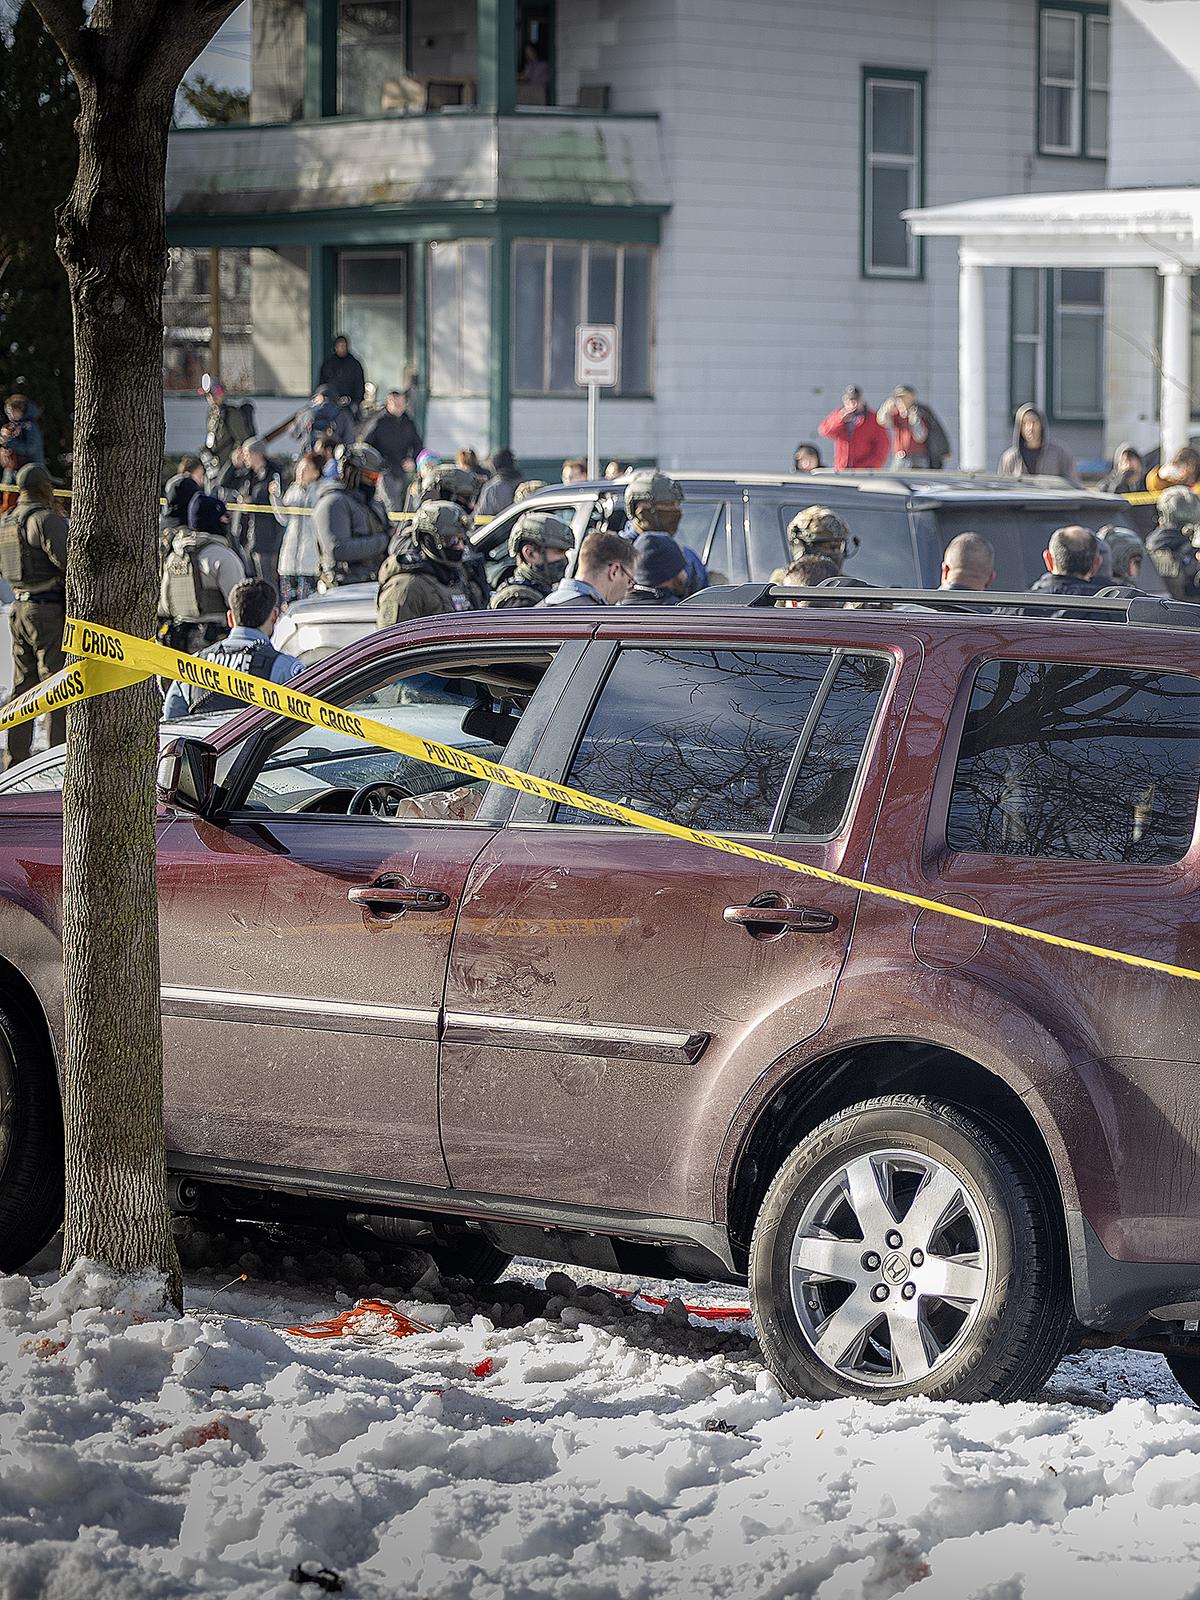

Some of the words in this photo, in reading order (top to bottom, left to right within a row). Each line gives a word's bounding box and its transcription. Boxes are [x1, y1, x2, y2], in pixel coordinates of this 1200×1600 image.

[82, 628, 124, 661] CROSS
[45, 670, 85, 706] CROSS
[177, 658, 224, 692] POLICE
[227, 675, 257, 703] LINE
[262, 687, 283, 711] DO
[286, 695, 315, 722] NOT
[319, 706, 366, 738] CROSS
[421, 740, 476, 774] POLICE
